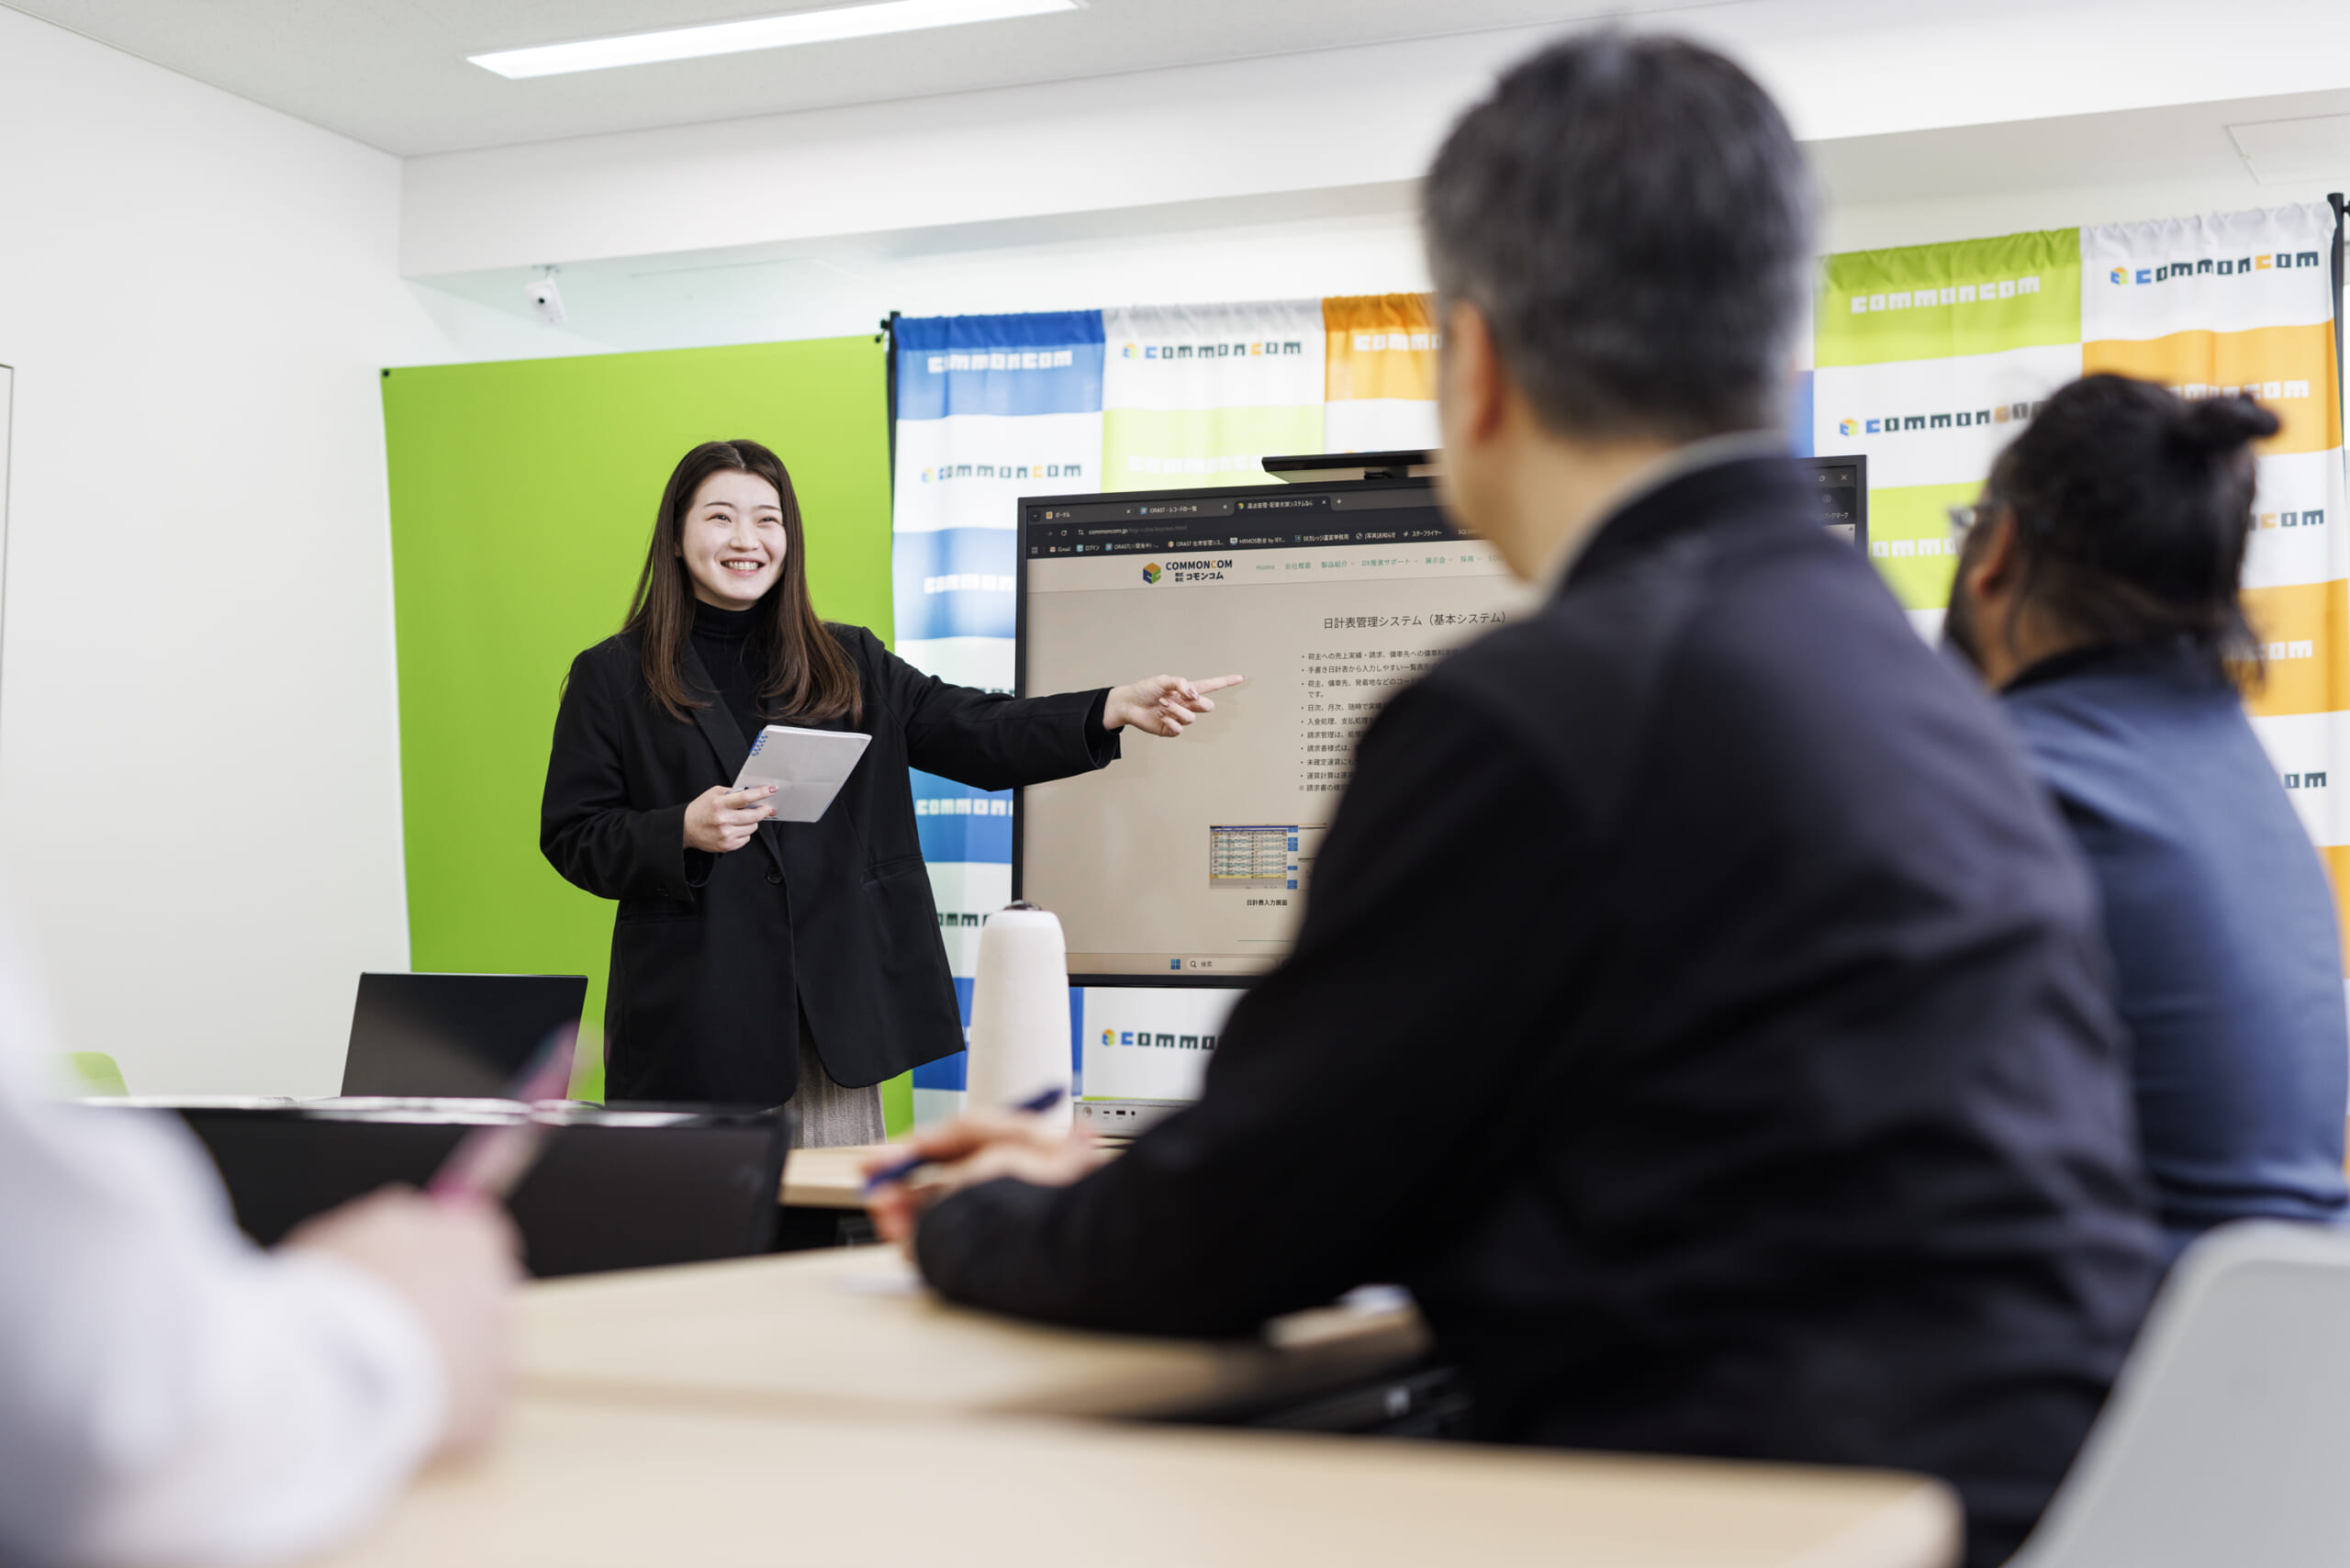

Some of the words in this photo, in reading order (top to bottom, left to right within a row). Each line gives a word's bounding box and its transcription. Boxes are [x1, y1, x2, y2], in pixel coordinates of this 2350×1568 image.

[1426, 555, 1446, 565] 展示会
[1460, 554, 1474, 564] 採用
[1166, 559, 1233, 571] COMMONCOM
[1285, 562, 1312, 571] 会社概要
[1321, 560, 1348, 569] 製品紹介
[1247, 899, 1288, 907] 日計表入力画面
